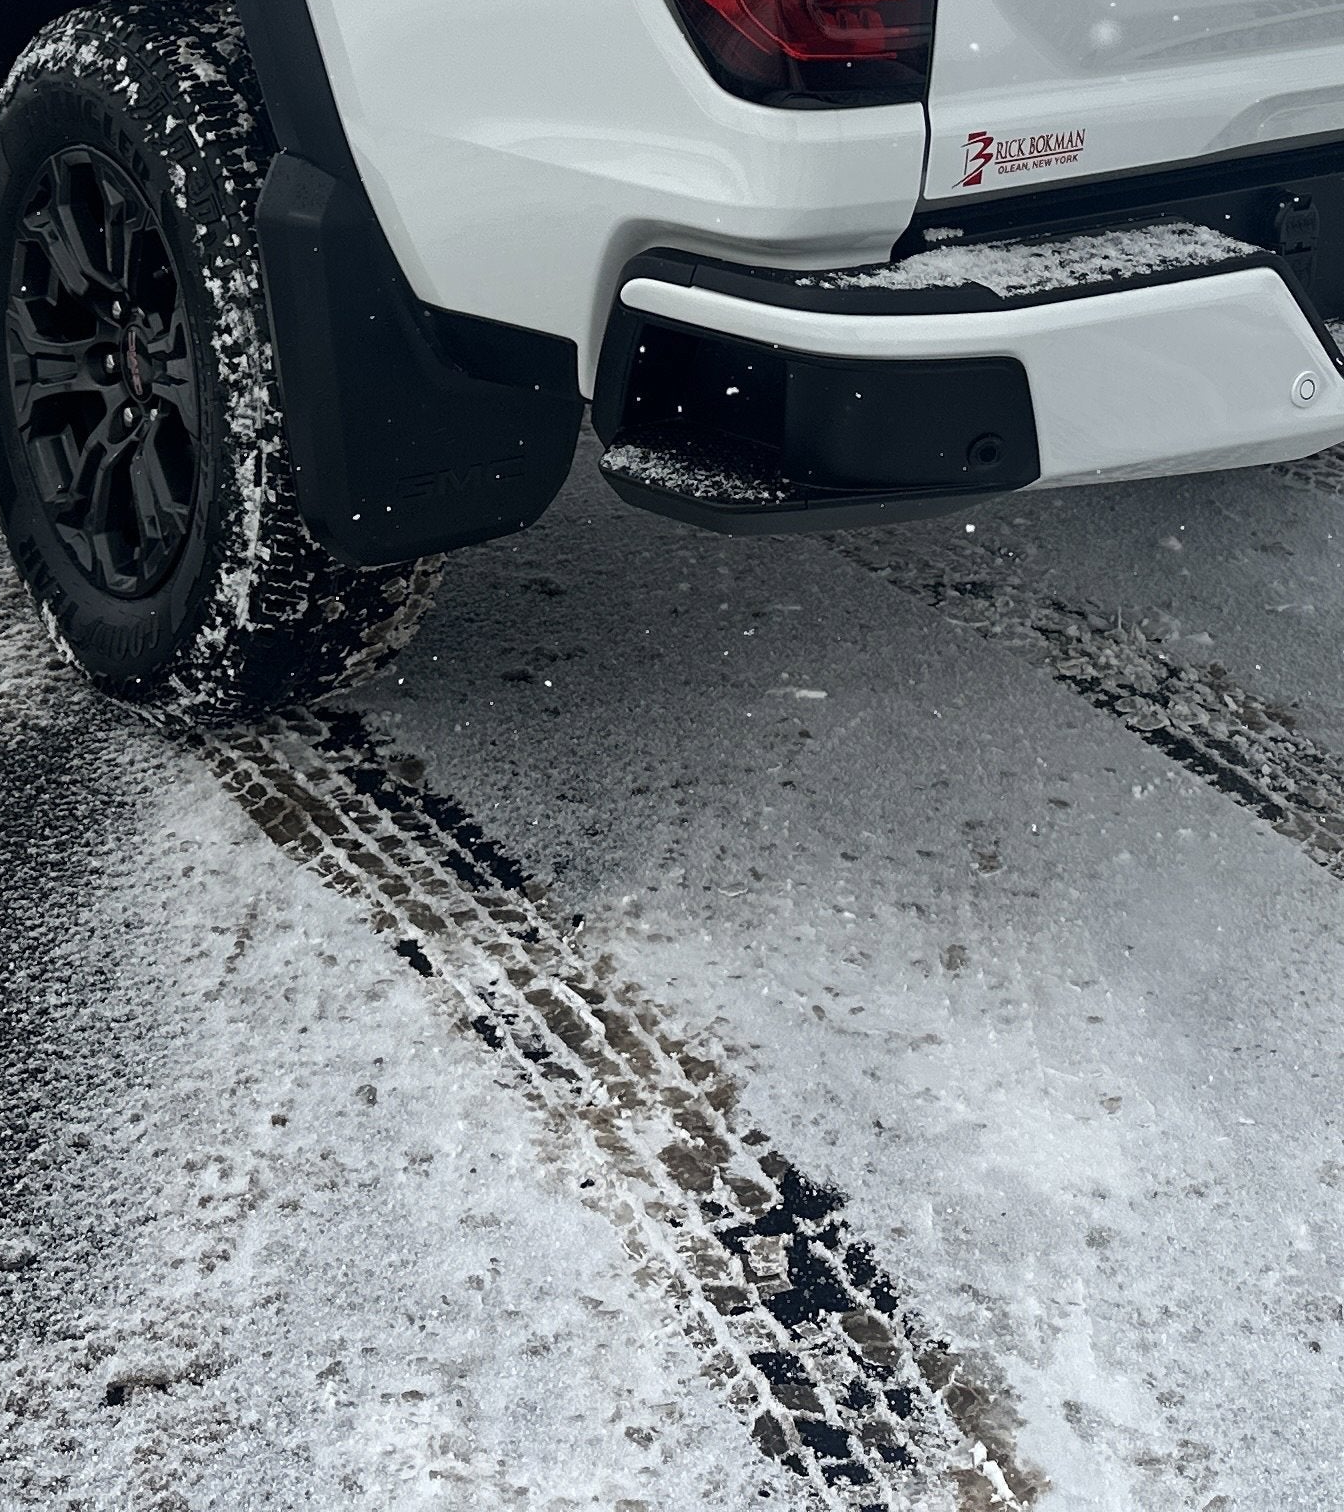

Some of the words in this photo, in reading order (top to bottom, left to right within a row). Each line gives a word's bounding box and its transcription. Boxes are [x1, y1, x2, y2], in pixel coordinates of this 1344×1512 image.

[995, 137, 1026, 160] RICK
[1028, 128, 1086, 156] BOKMAN
[997, 162, 1031, 175] OLEAN,
[1032, 157, 1052, 170] NEW
[1055, 153, 1079, 166] YORK
